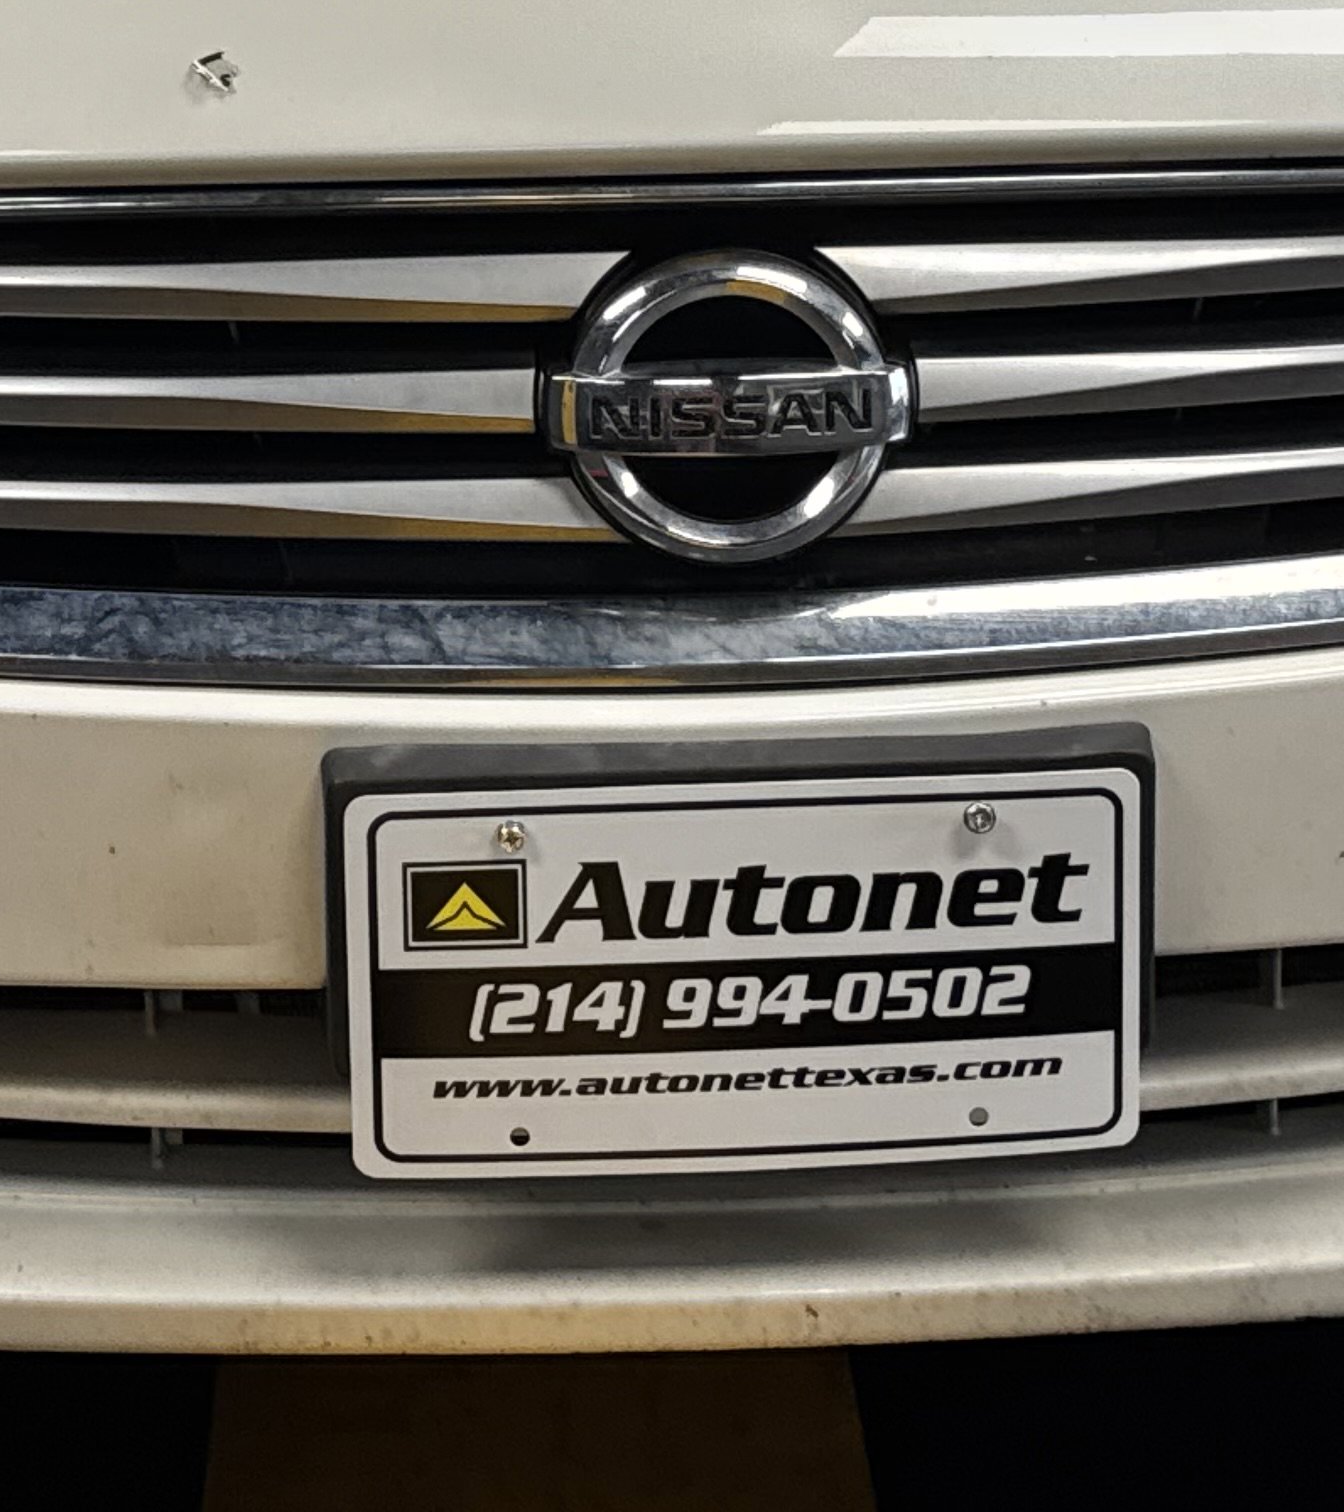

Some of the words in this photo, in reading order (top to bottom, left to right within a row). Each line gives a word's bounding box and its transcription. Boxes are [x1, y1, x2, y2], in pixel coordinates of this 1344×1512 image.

[590, 389, 872, 439] NISSAN
[536, 852, 1090, 944] Autonet
[469, 980, 646, 1042] (214)
[662, 965, 1032, 1029] 994-0502
[432, 1056, 1062, 1100] www.autonettexas.com
